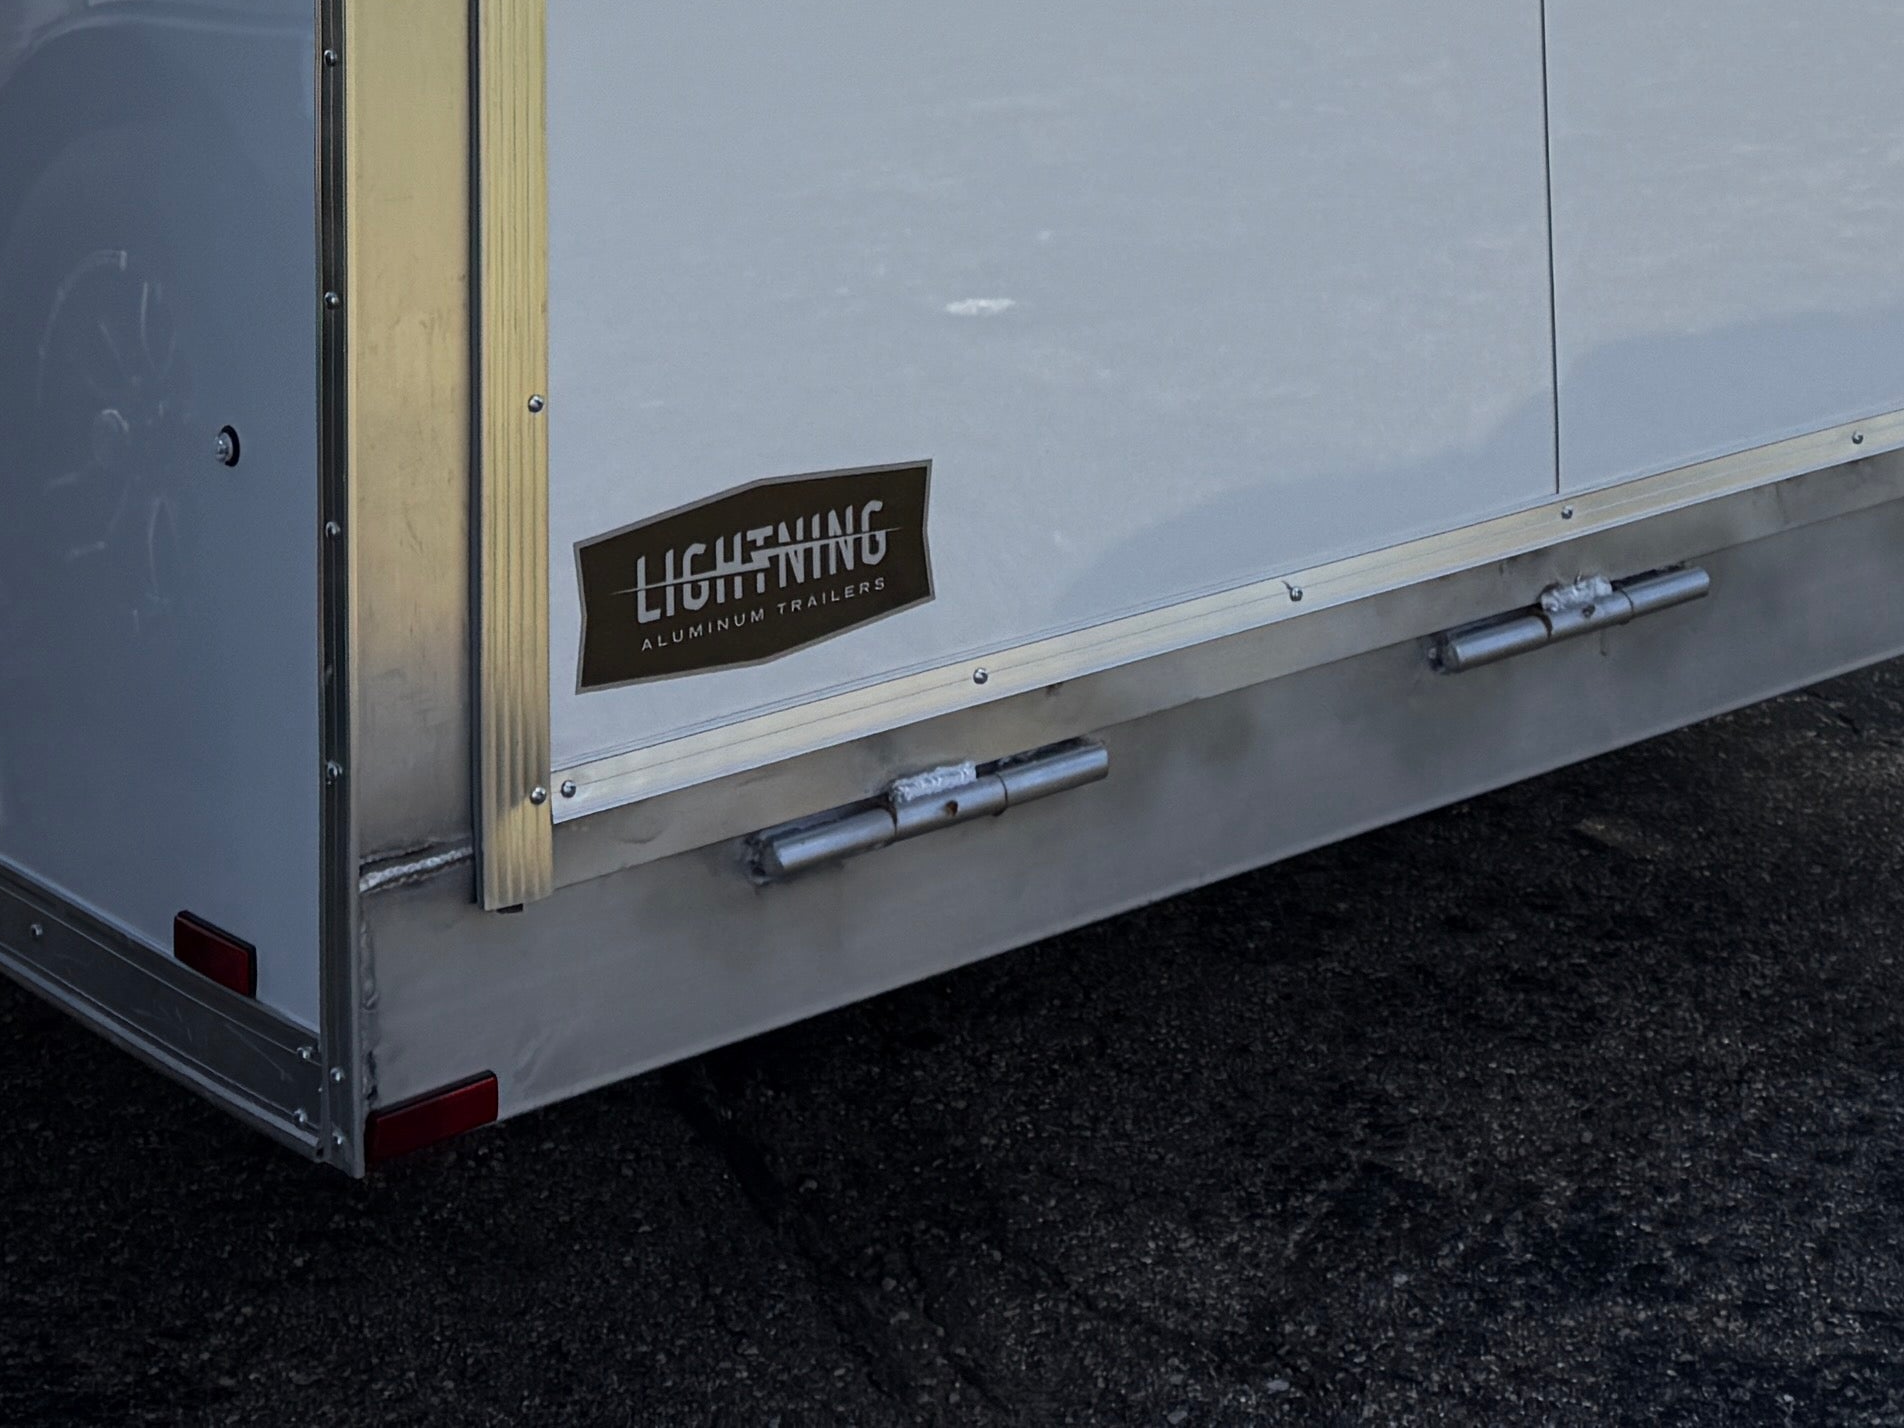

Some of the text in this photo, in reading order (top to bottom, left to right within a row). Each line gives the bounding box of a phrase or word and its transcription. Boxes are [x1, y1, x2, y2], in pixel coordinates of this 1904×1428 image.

[635, 499, 888, 624] LIGHTNING
[641, 577, 886, 652] ALUMINUM TRAILERS
